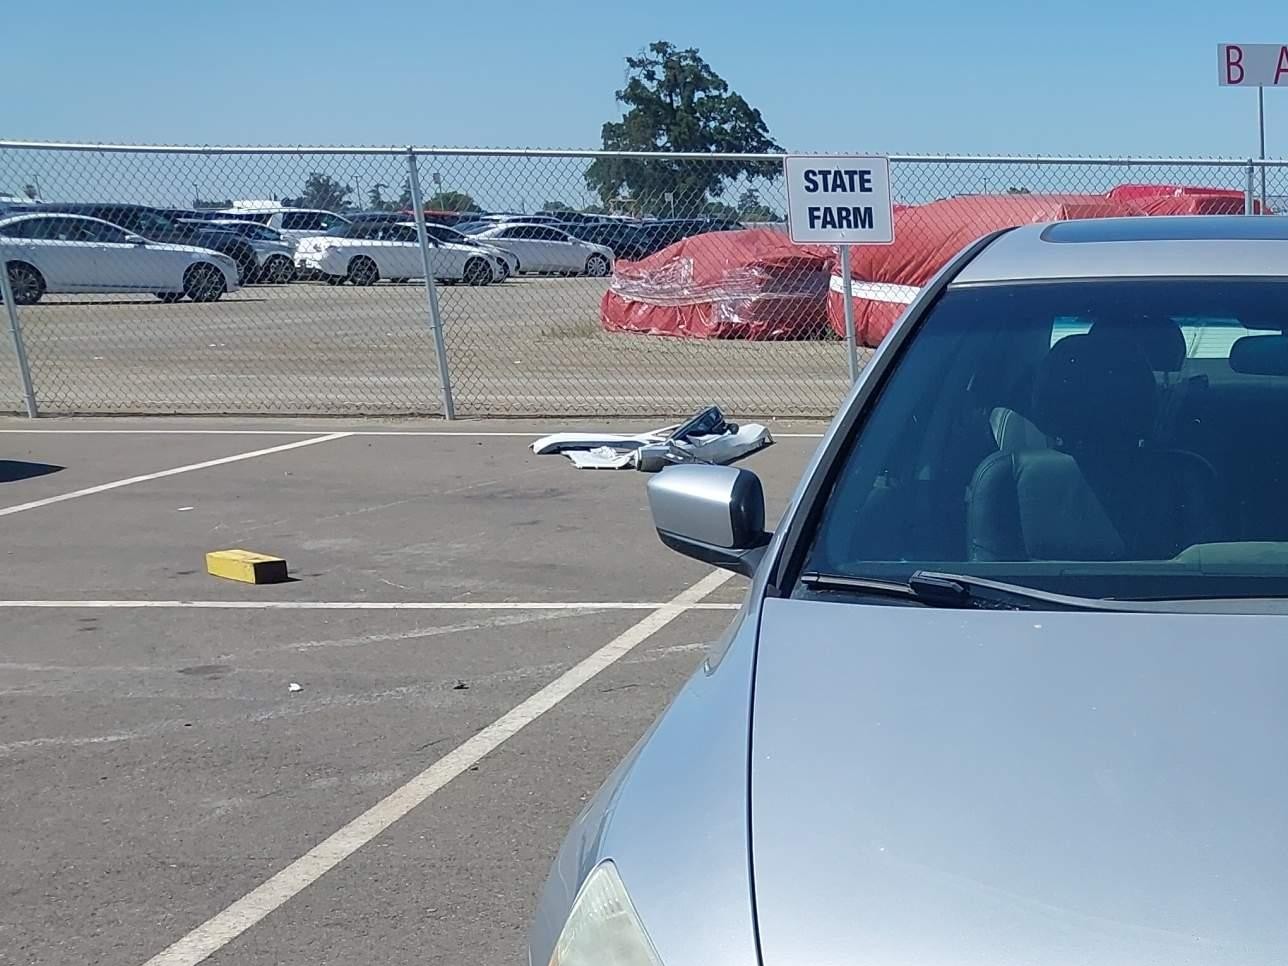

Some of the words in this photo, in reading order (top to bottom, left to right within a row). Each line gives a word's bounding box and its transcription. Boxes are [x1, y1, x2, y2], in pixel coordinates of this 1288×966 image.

[1226, 45, 1244, 84] B
[803, 169, 873, 193] STATE
[807, 206, 874, 229] FARM
